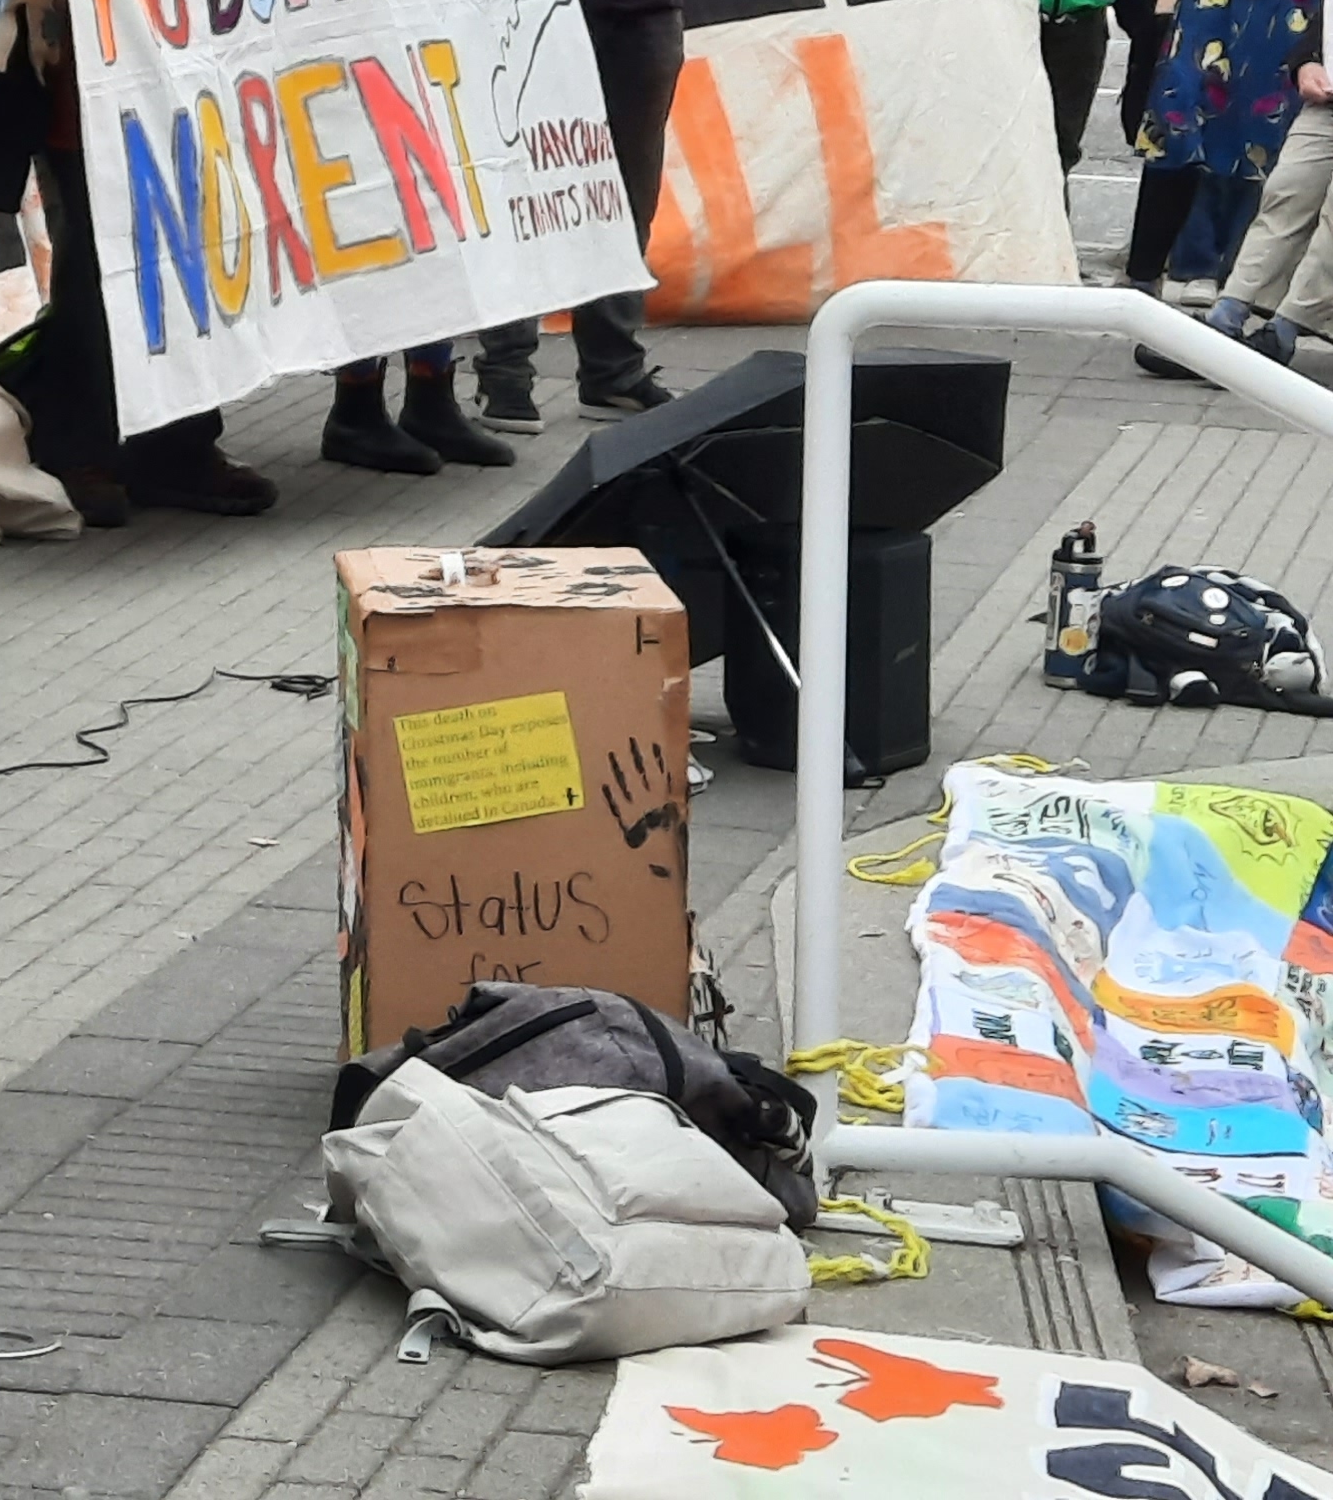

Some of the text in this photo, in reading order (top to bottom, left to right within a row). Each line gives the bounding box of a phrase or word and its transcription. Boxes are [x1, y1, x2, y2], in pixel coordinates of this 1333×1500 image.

[119, 38, 492, 359] NO RENT
[400, 706, 498, 732] This death on
[402, 714, 569, 750] Christmas Day exposes
[405, 741, 509, 771] the number of
[501, 754, 570, 774] including
[481, 781, 512, 797] who
[515, 780, 541, 792] are
[484, 806, 499, 819] in
[399, 870, 610, 944] Status
[459, 952, 542, 985] for
